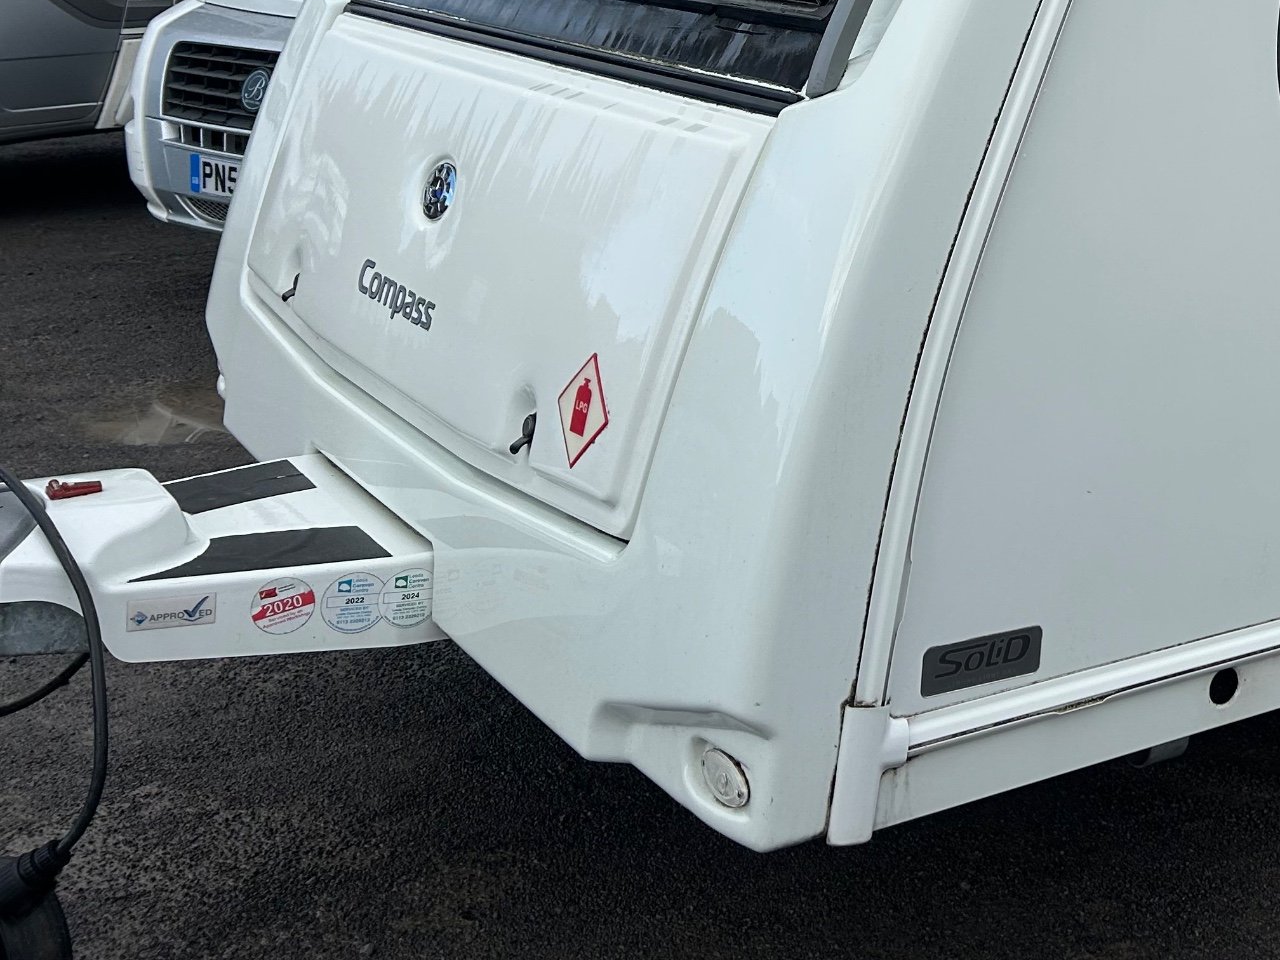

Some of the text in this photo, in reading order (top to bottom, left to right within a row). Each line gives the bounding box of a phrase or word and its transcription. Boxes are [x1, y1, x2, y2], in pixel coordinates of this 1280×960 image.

[357, 258, 436, 332] Compass
[575, 400, 588, 414] LPG
[344, 596, 365, 605] 2022
[401, 591, 420, 601] 2024
[263, 595, 303, 617] 2020
